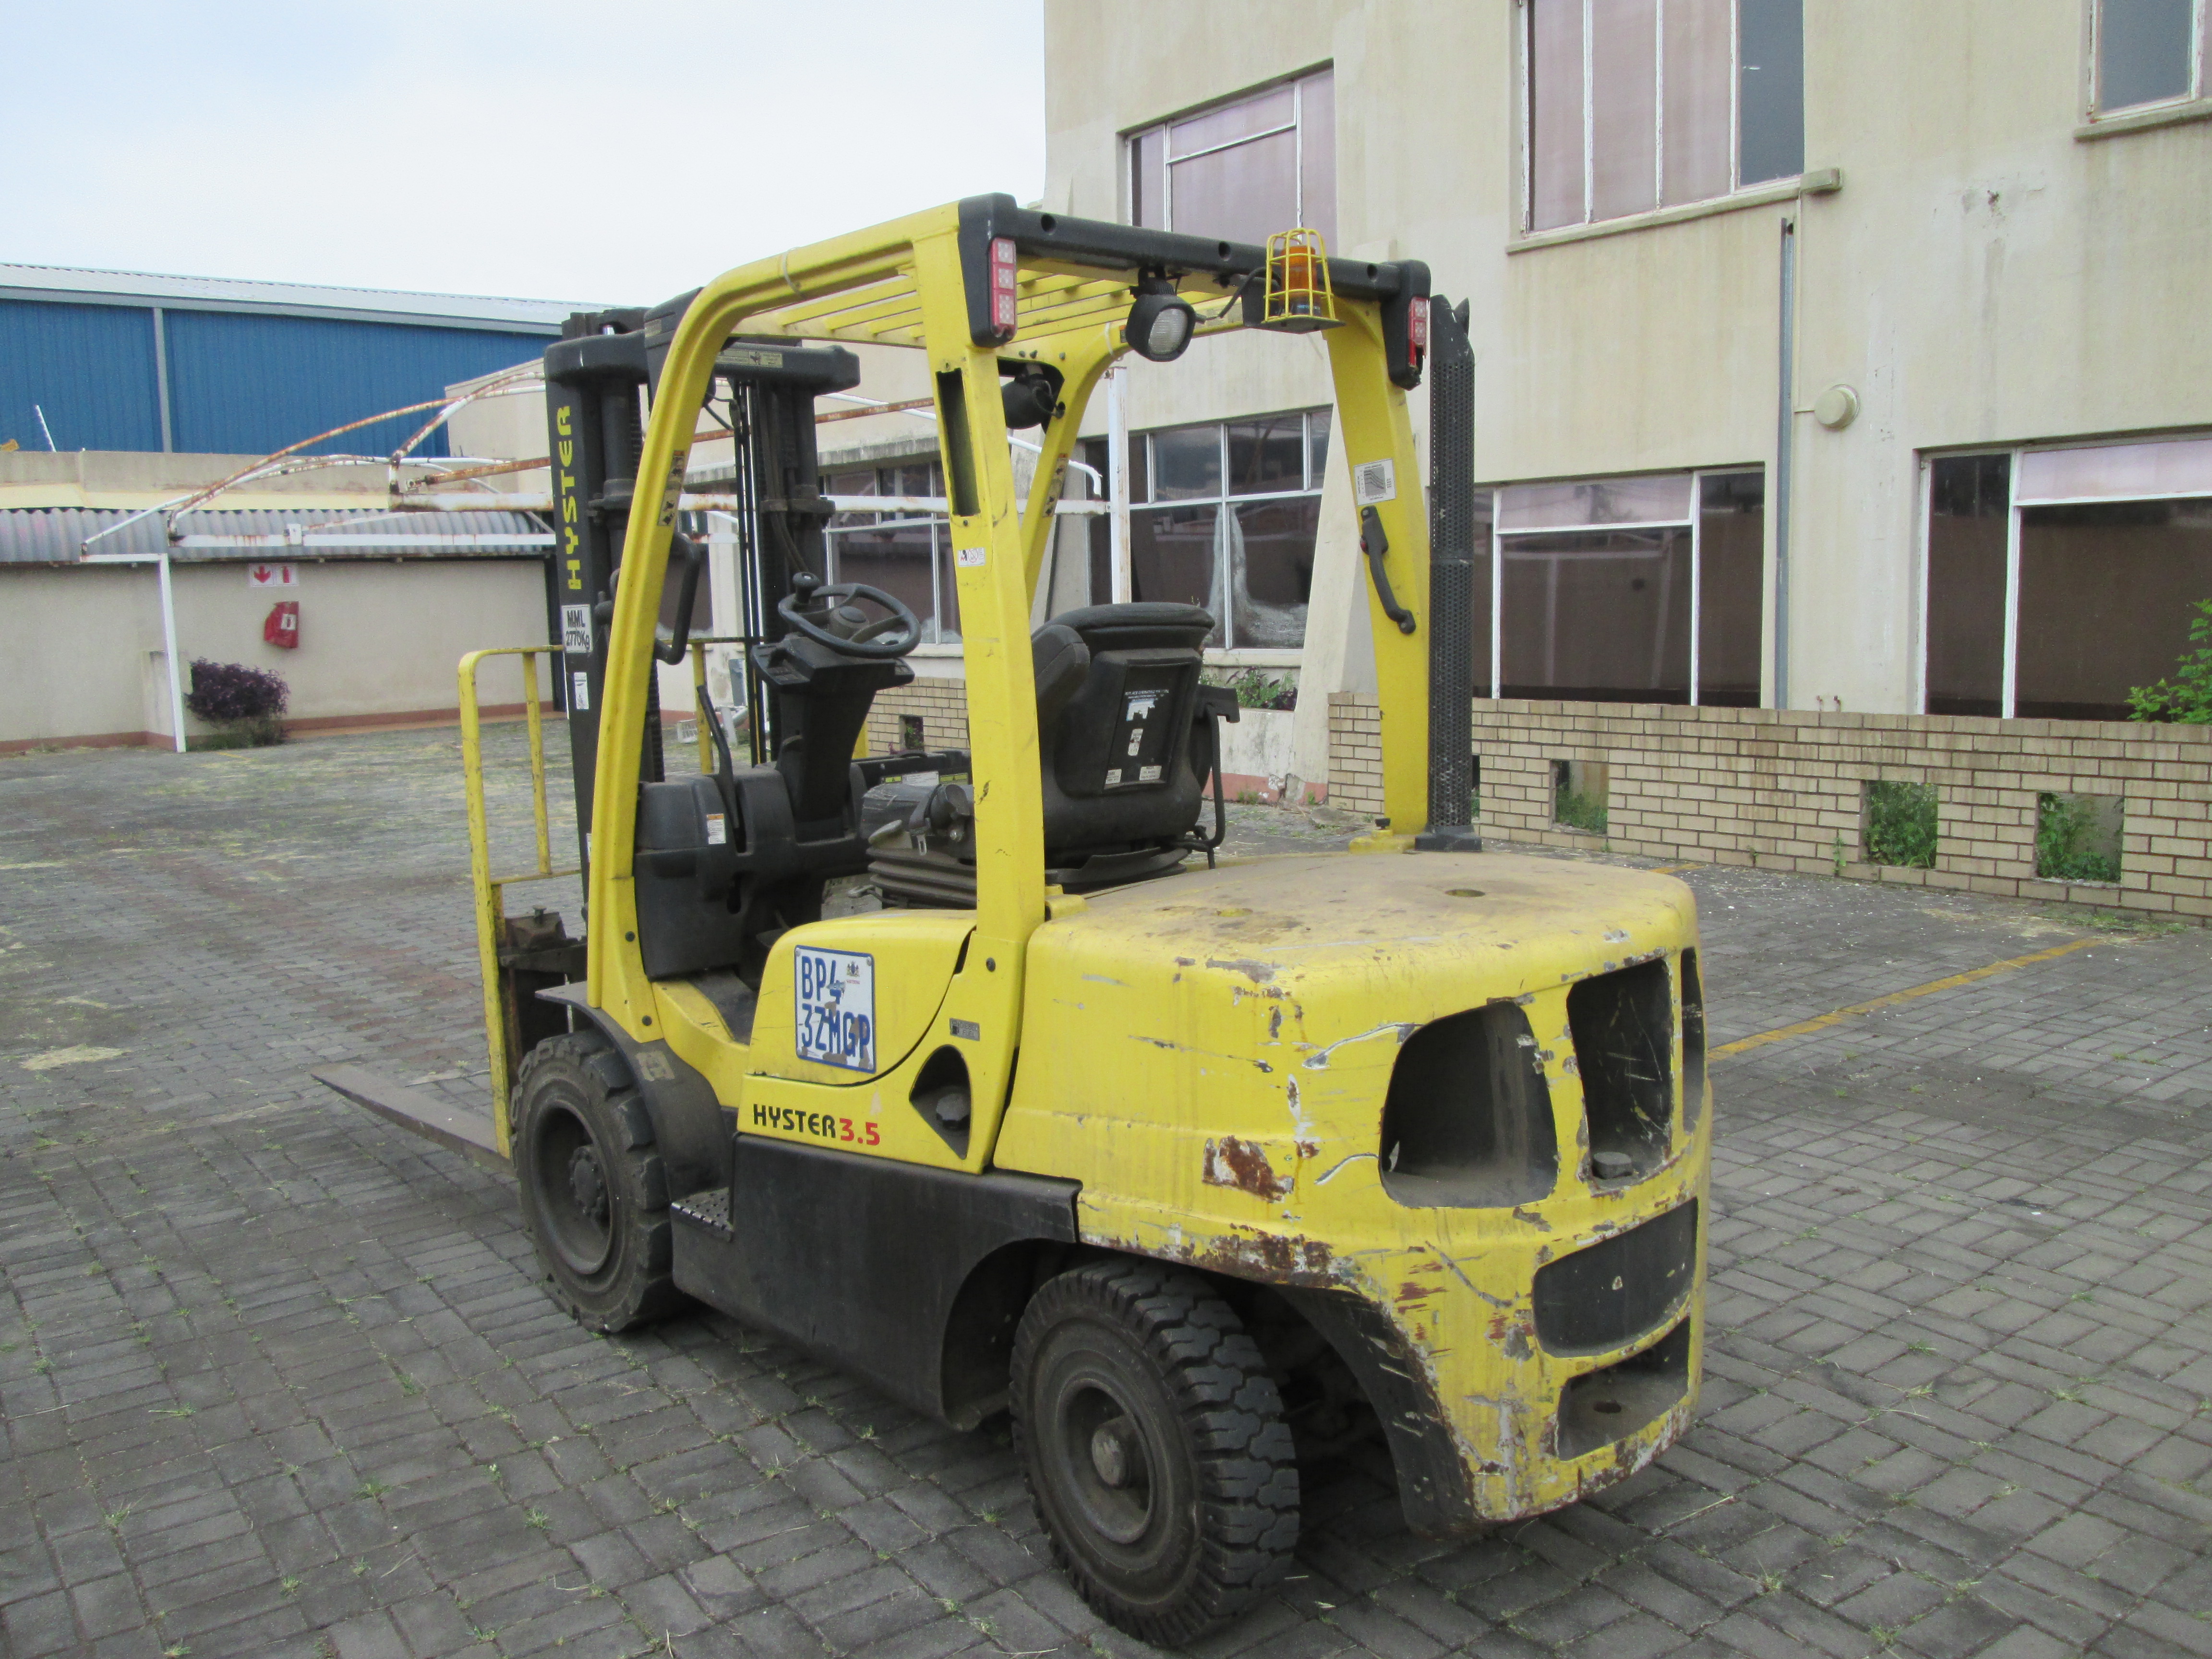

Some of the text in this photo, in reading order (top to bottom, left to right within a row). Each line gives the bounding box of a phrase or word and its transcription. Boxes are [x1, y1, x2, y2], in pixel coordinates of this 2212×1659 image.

[556, 405, 582, 589] HYSTER
[567, 610, 585, 628] MML
[565, 630, 590, 650] 2770Kg
[753, 1103, 880, 1146] HYSTER 3.5
